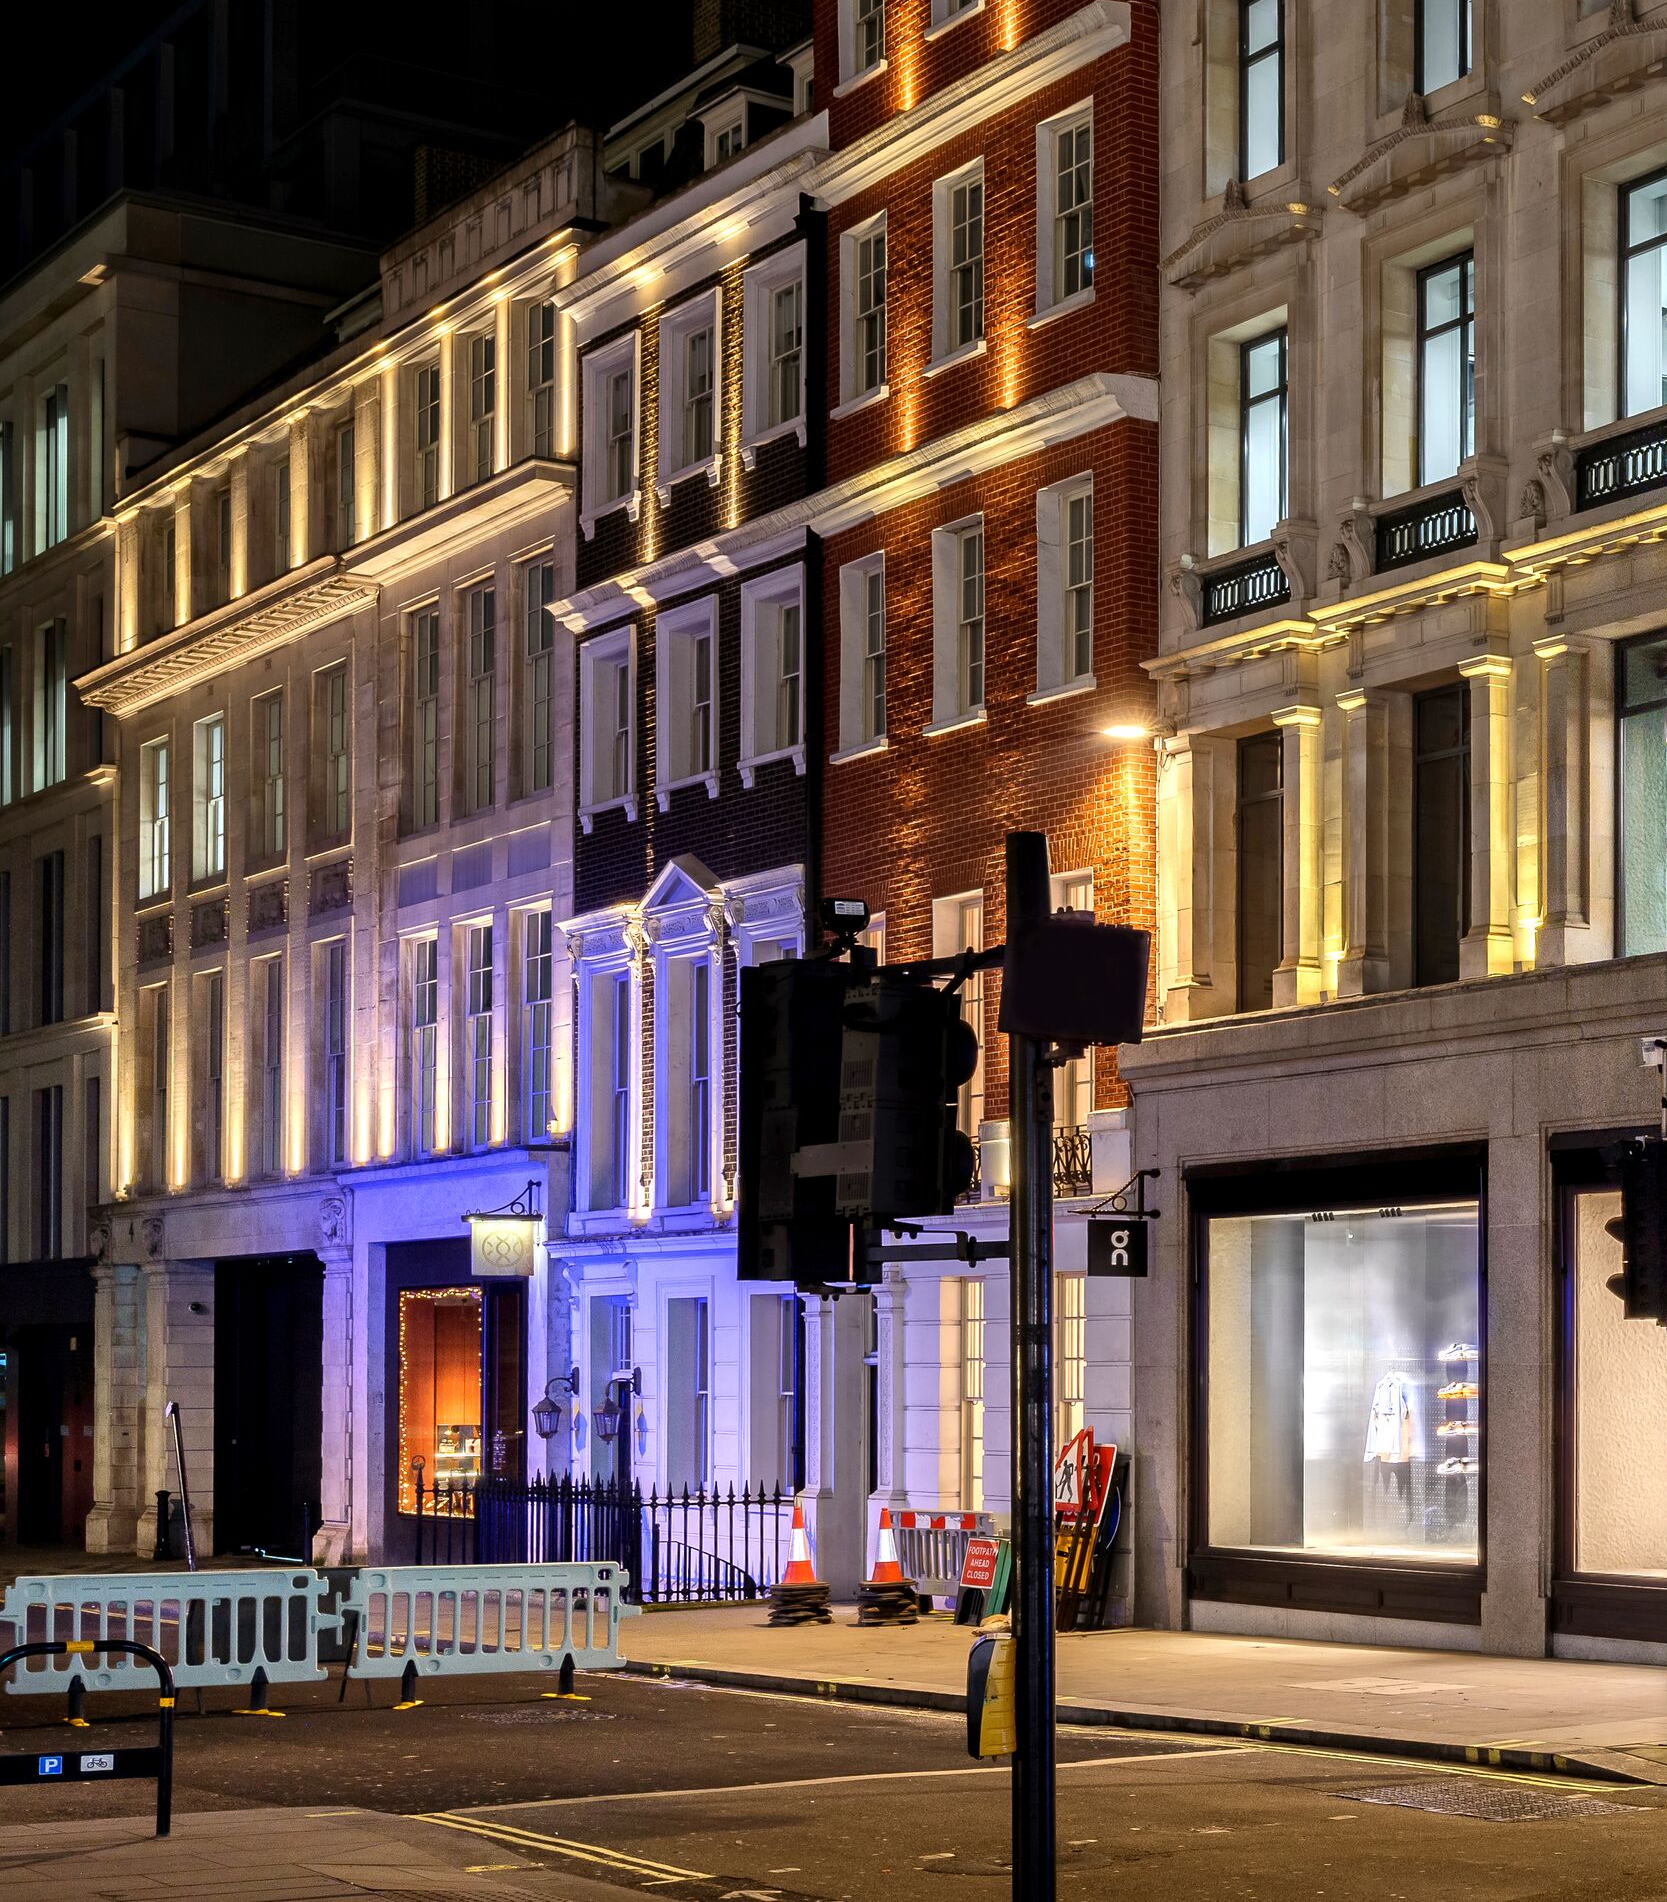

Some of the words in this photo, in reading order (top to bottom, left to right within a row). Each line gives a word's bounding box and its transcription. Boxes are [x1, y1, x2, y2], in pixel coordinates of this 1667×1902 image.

[970, 1559, 990, 1568] AHEAD
[966, 1570, 990, 1580] CLOSED
[45, 1759, 58, 1773] P
